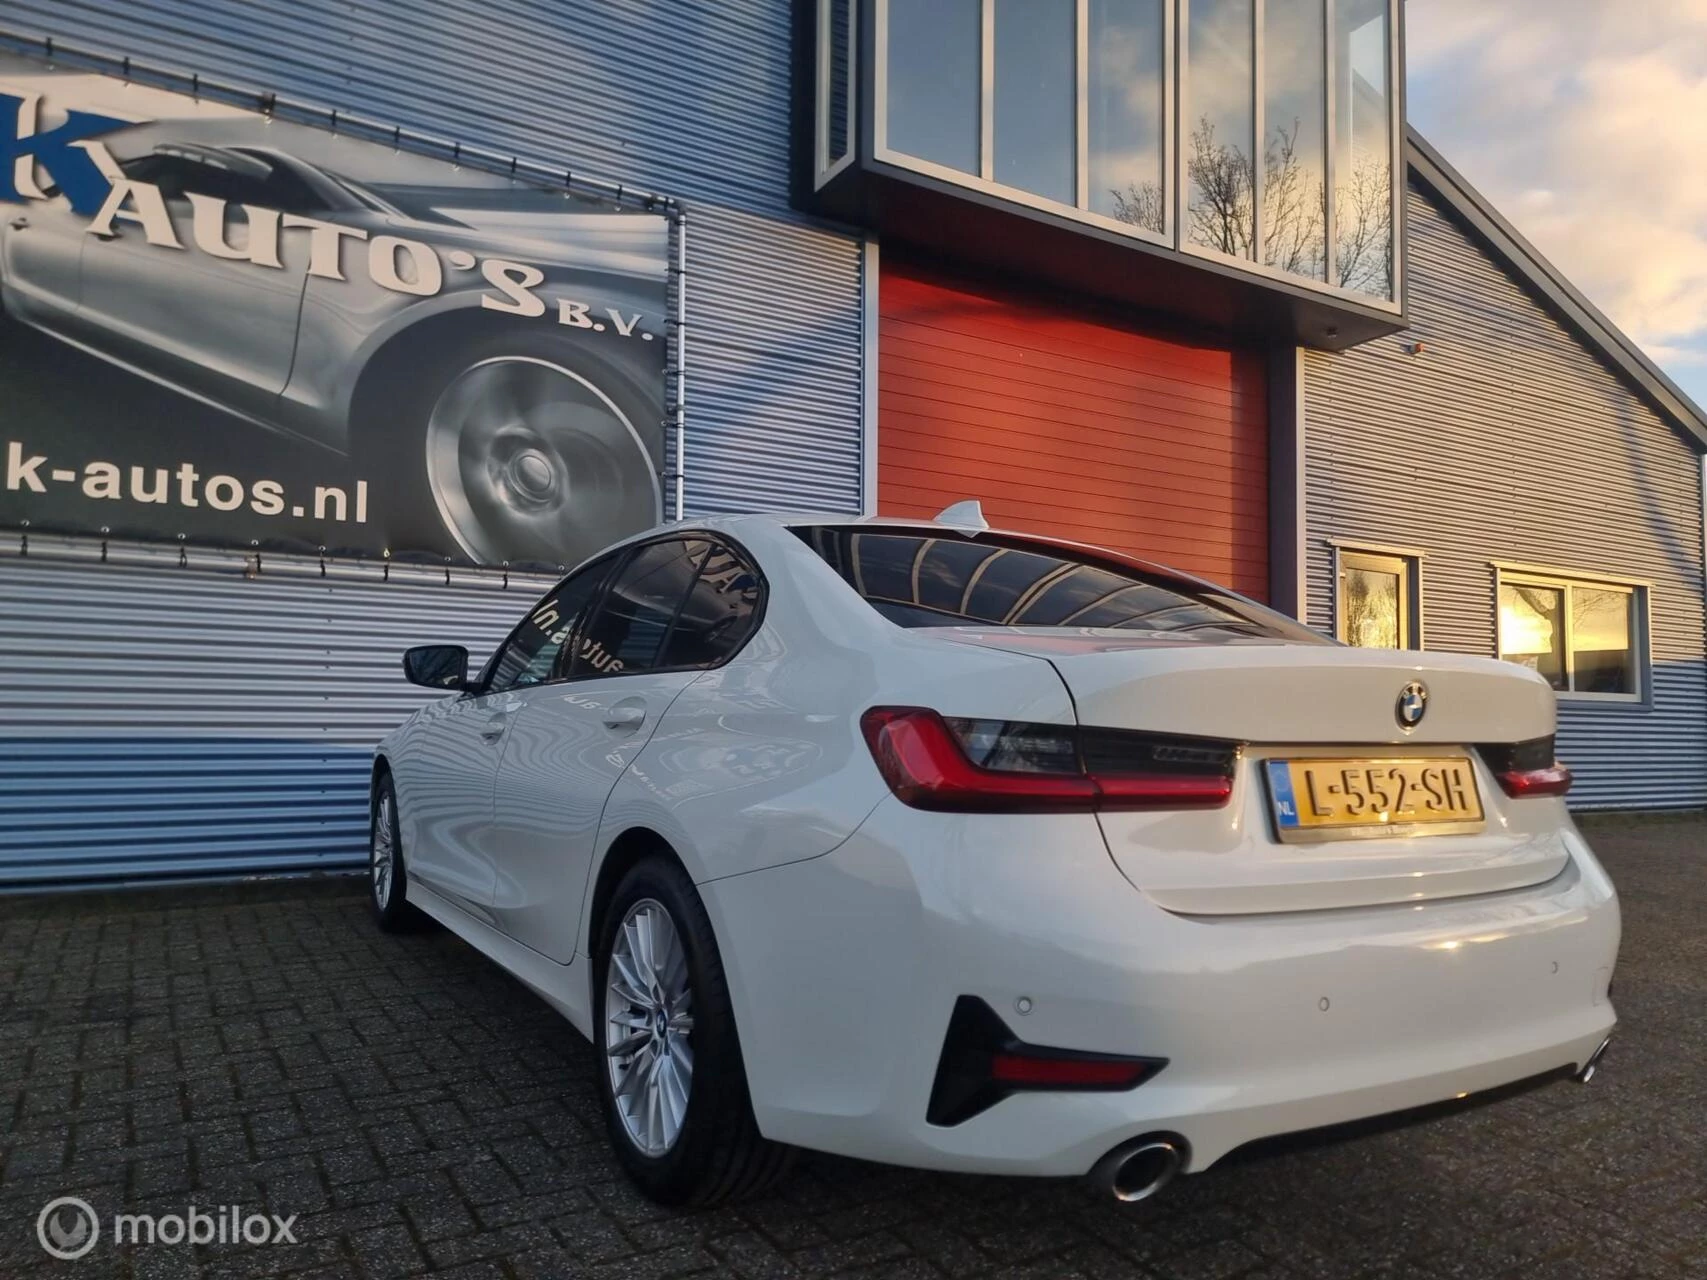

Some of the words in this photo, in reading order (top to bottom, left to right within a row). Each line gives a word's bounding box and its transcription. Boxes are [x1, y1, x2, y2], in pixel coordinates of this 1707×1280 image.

[557, 298, 654, 341] B.V.
[6, 441, 368, 523] k-autos.nl
[1277, 801, 1295, 816] NL
[1304, 768, 1469, 817] L-552-SH
